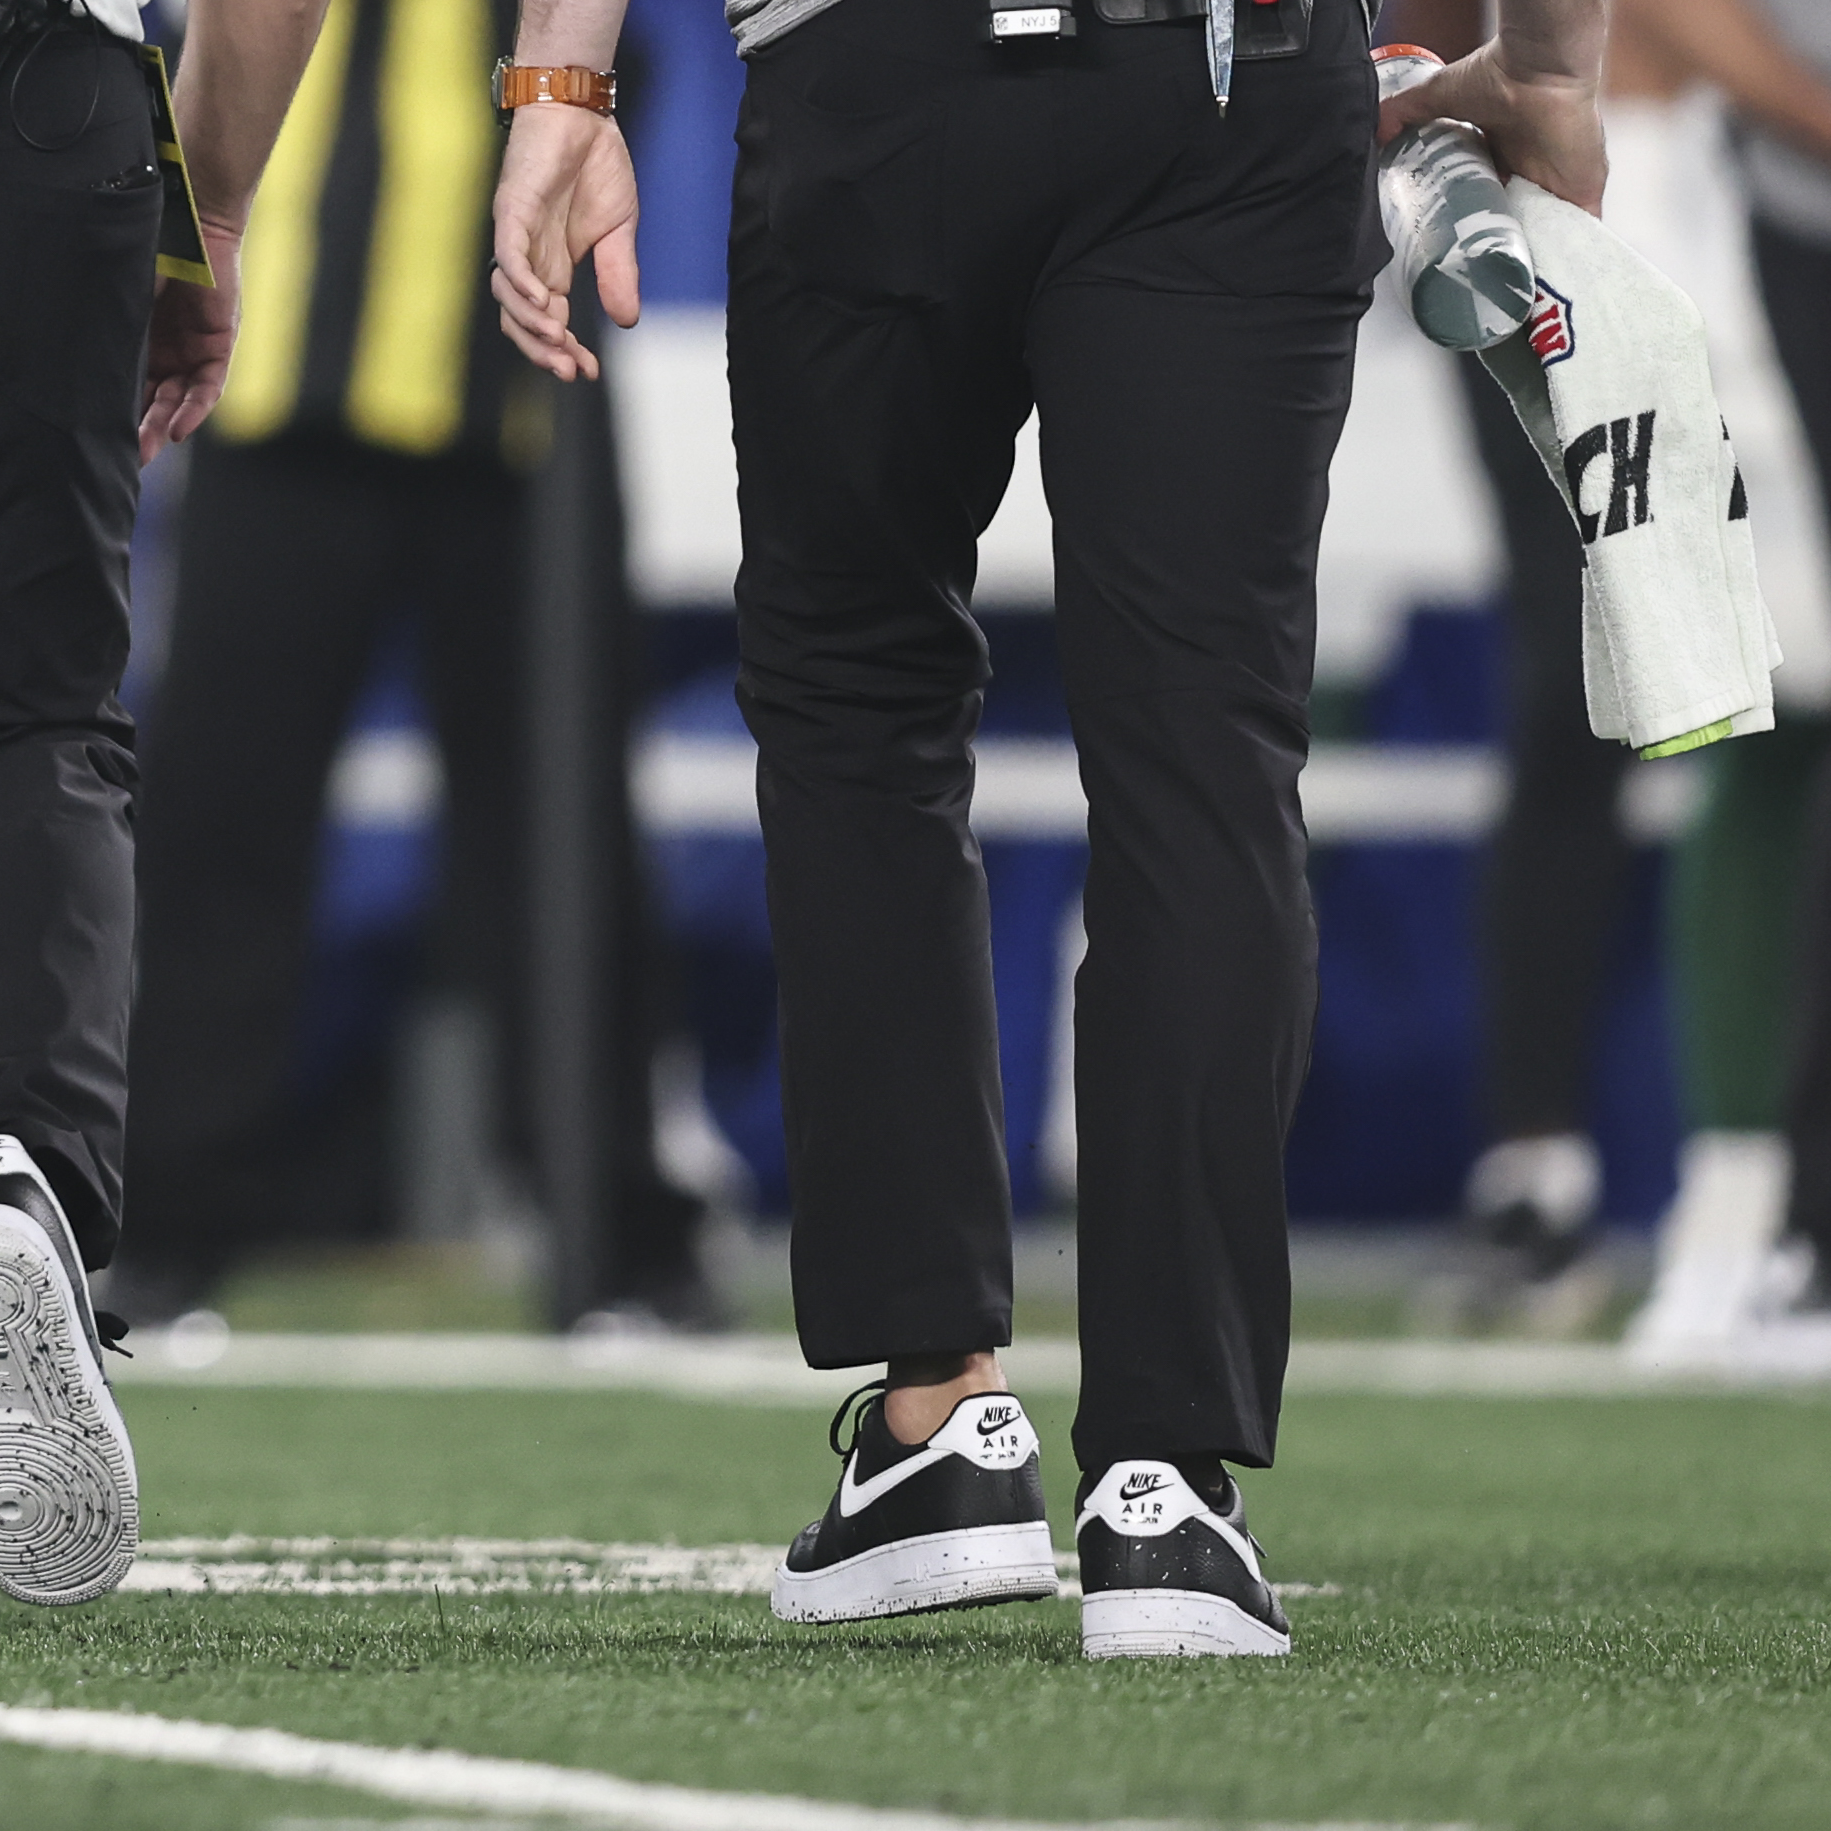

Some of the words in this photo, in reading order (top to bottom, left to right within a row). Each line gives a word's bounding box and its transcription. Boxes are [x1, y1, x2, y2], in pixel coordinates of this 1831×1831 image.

[1021, 15, 1046, 28] NYJ
[983, 1406, 1012, 1422] NIKE
[983, 1435, 1018, 1449] AIR
[1127, 1472, 1162, 1489] NIKE
[1122, 1502, 1163, 1515] AIR
